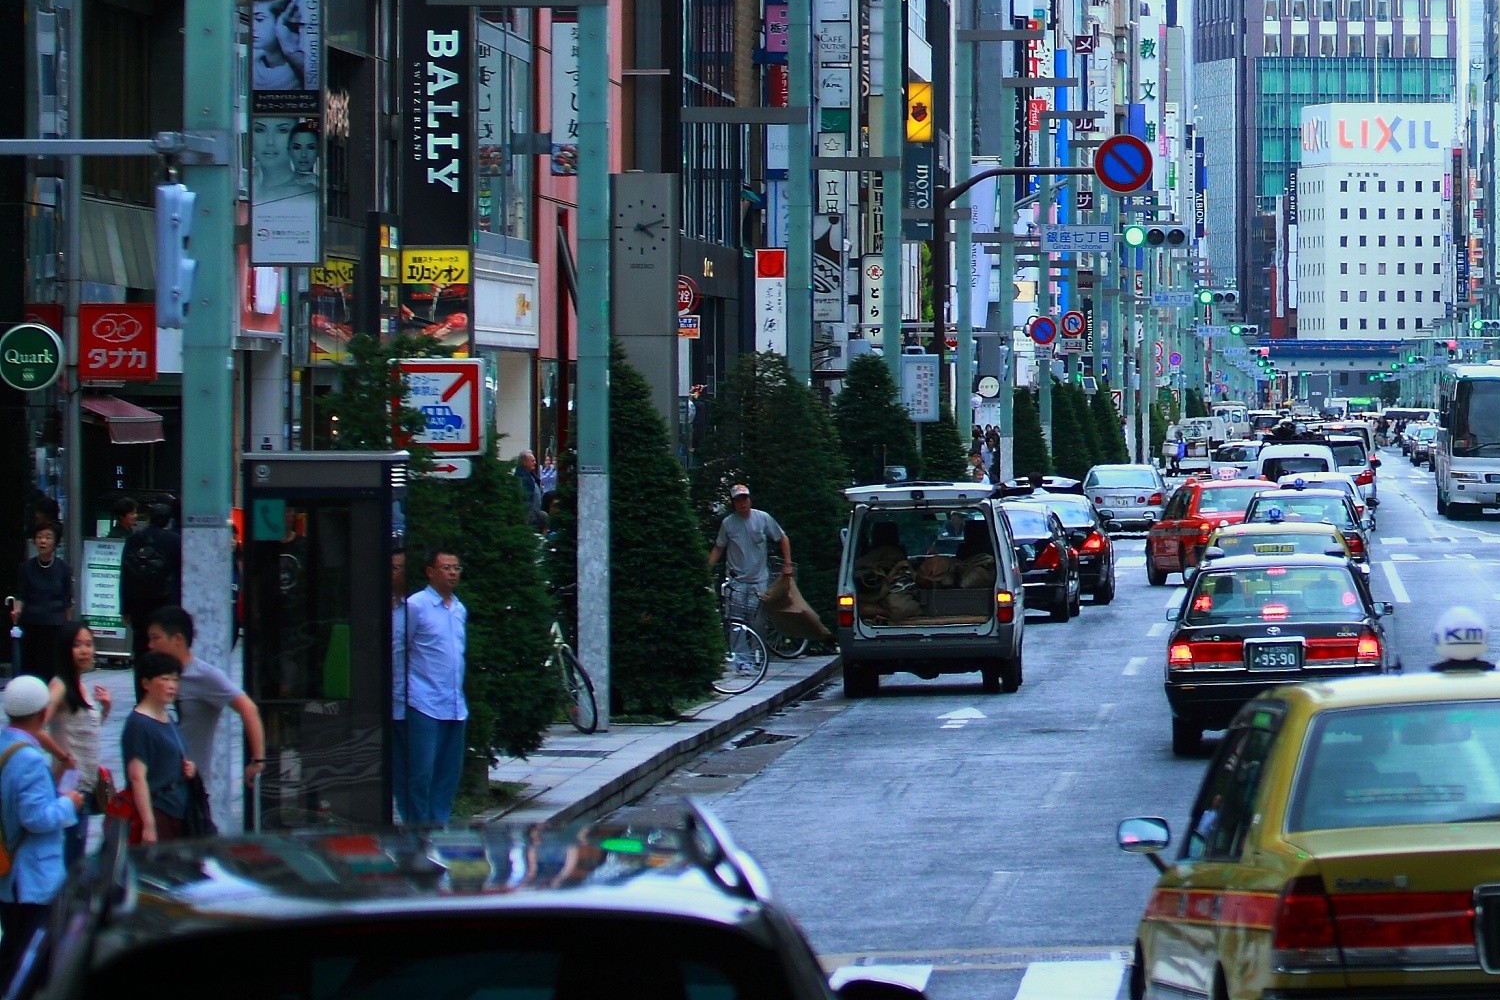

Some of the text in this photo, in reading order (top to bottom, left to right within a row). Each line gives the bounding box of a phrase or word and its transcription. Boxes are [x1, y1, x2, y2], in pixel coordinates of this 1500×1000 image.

[412, 61, 422, 162] SWITZERLAND
[426, 29, 459, 193] BALLY
[1337, 115, 1440, 153] LIXIL
[1195, 192, 1204, 224] ALBION
[1046, 231, 1110, 243] 銀座七丁目
[869, 287, 881, 338] とらや
[4, 348, 55, 364] Quark
[87, 347, 147, 369] タナカ
[1261, 653, 1296, 666] 95-90
